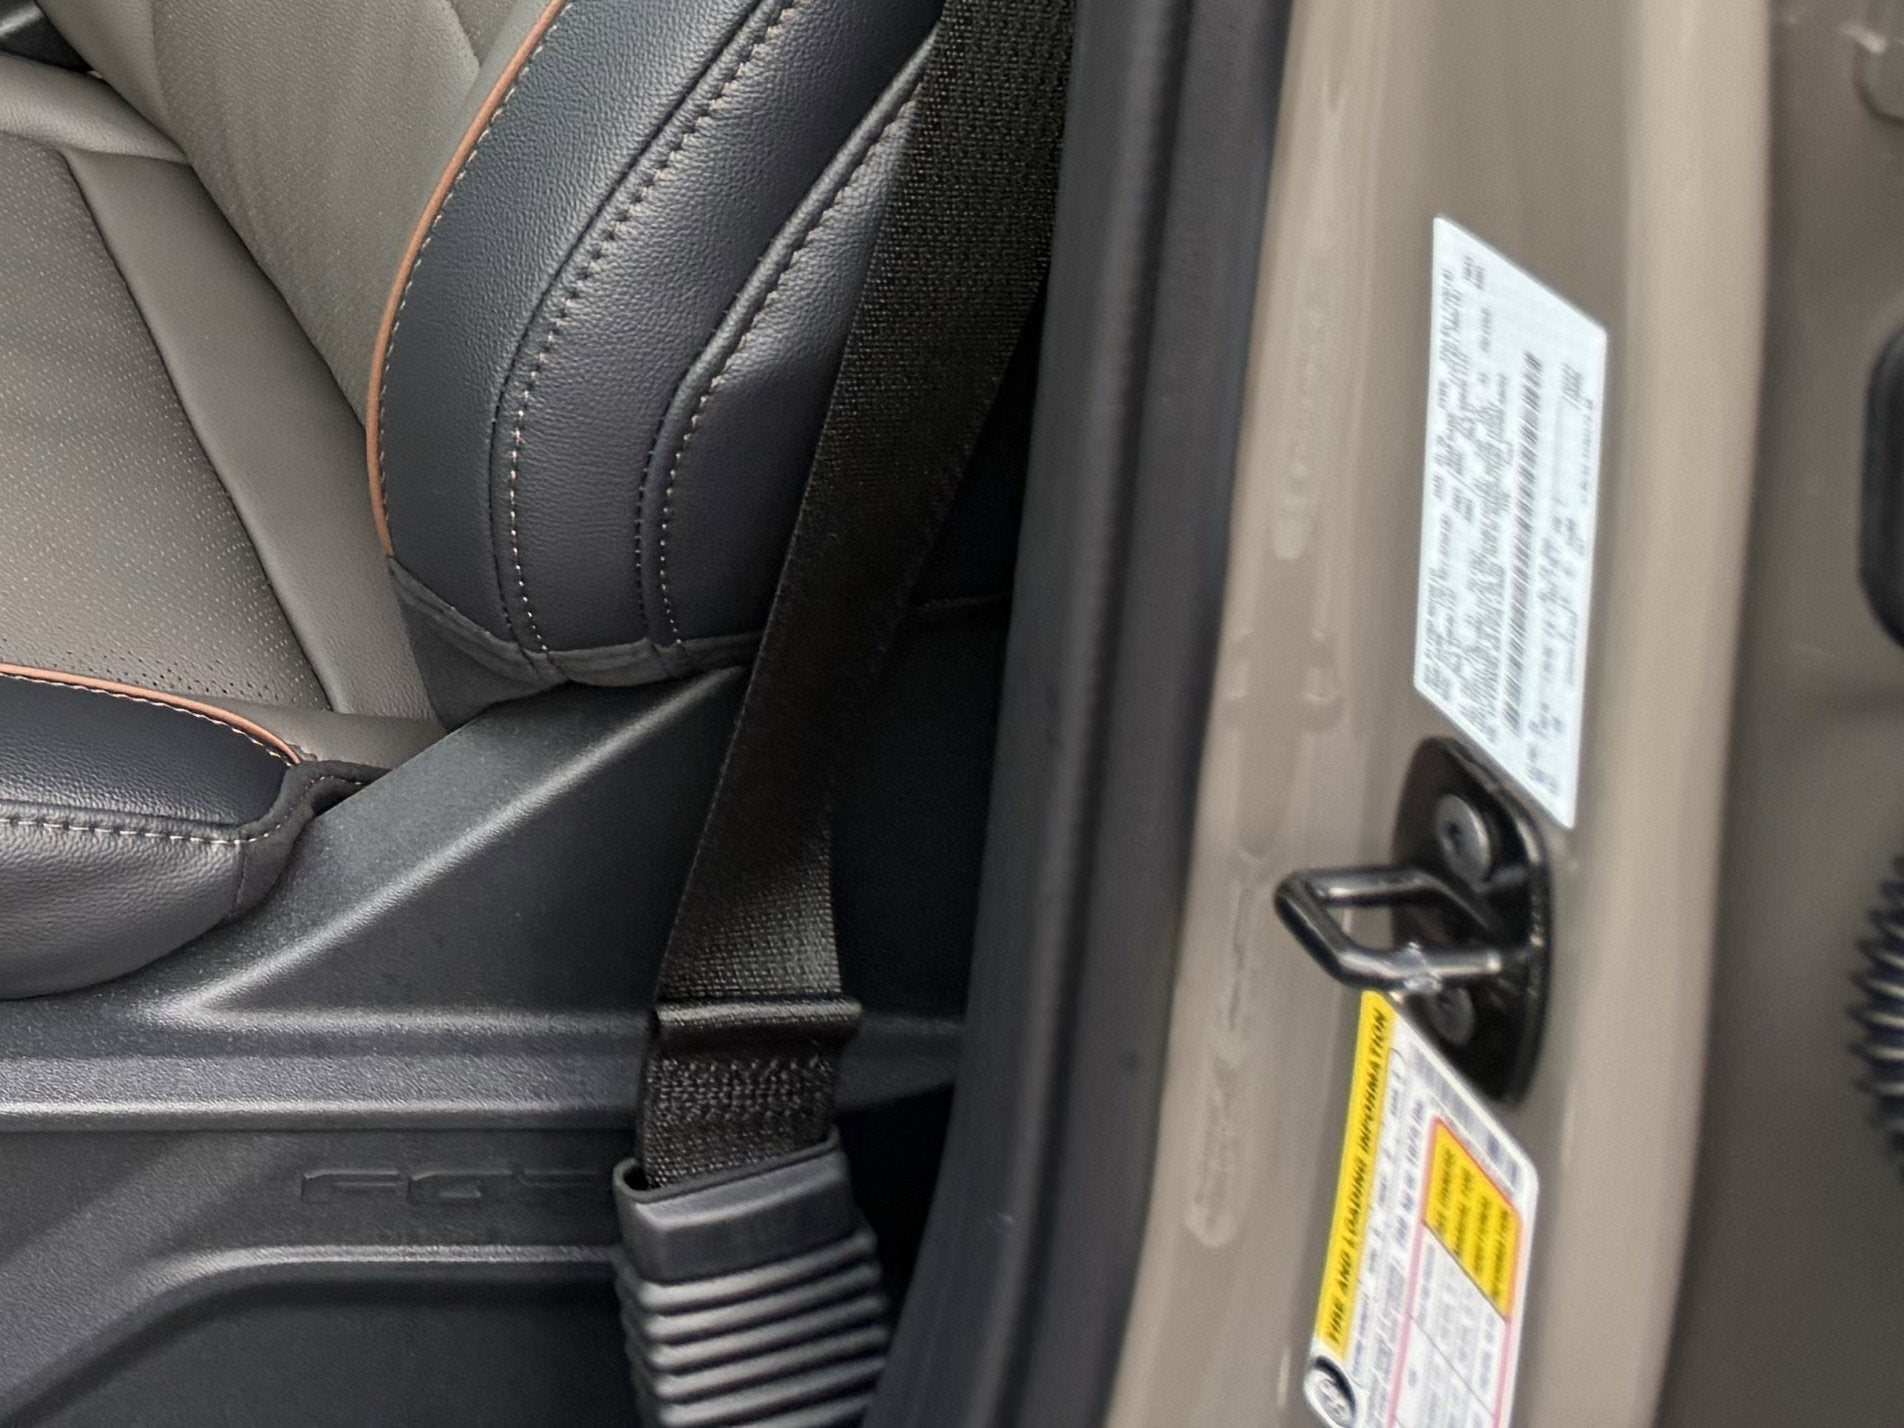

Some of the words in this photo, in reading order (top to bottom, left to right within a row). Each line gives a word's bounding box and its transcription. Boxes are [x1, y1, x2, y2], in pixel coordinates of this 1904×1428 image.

[1360, 1008, 1387, 1154] INFORMATION
[1344, 1159, 1367, 1249] LOADING
[1338, 1252, 1355, 1294] AND
